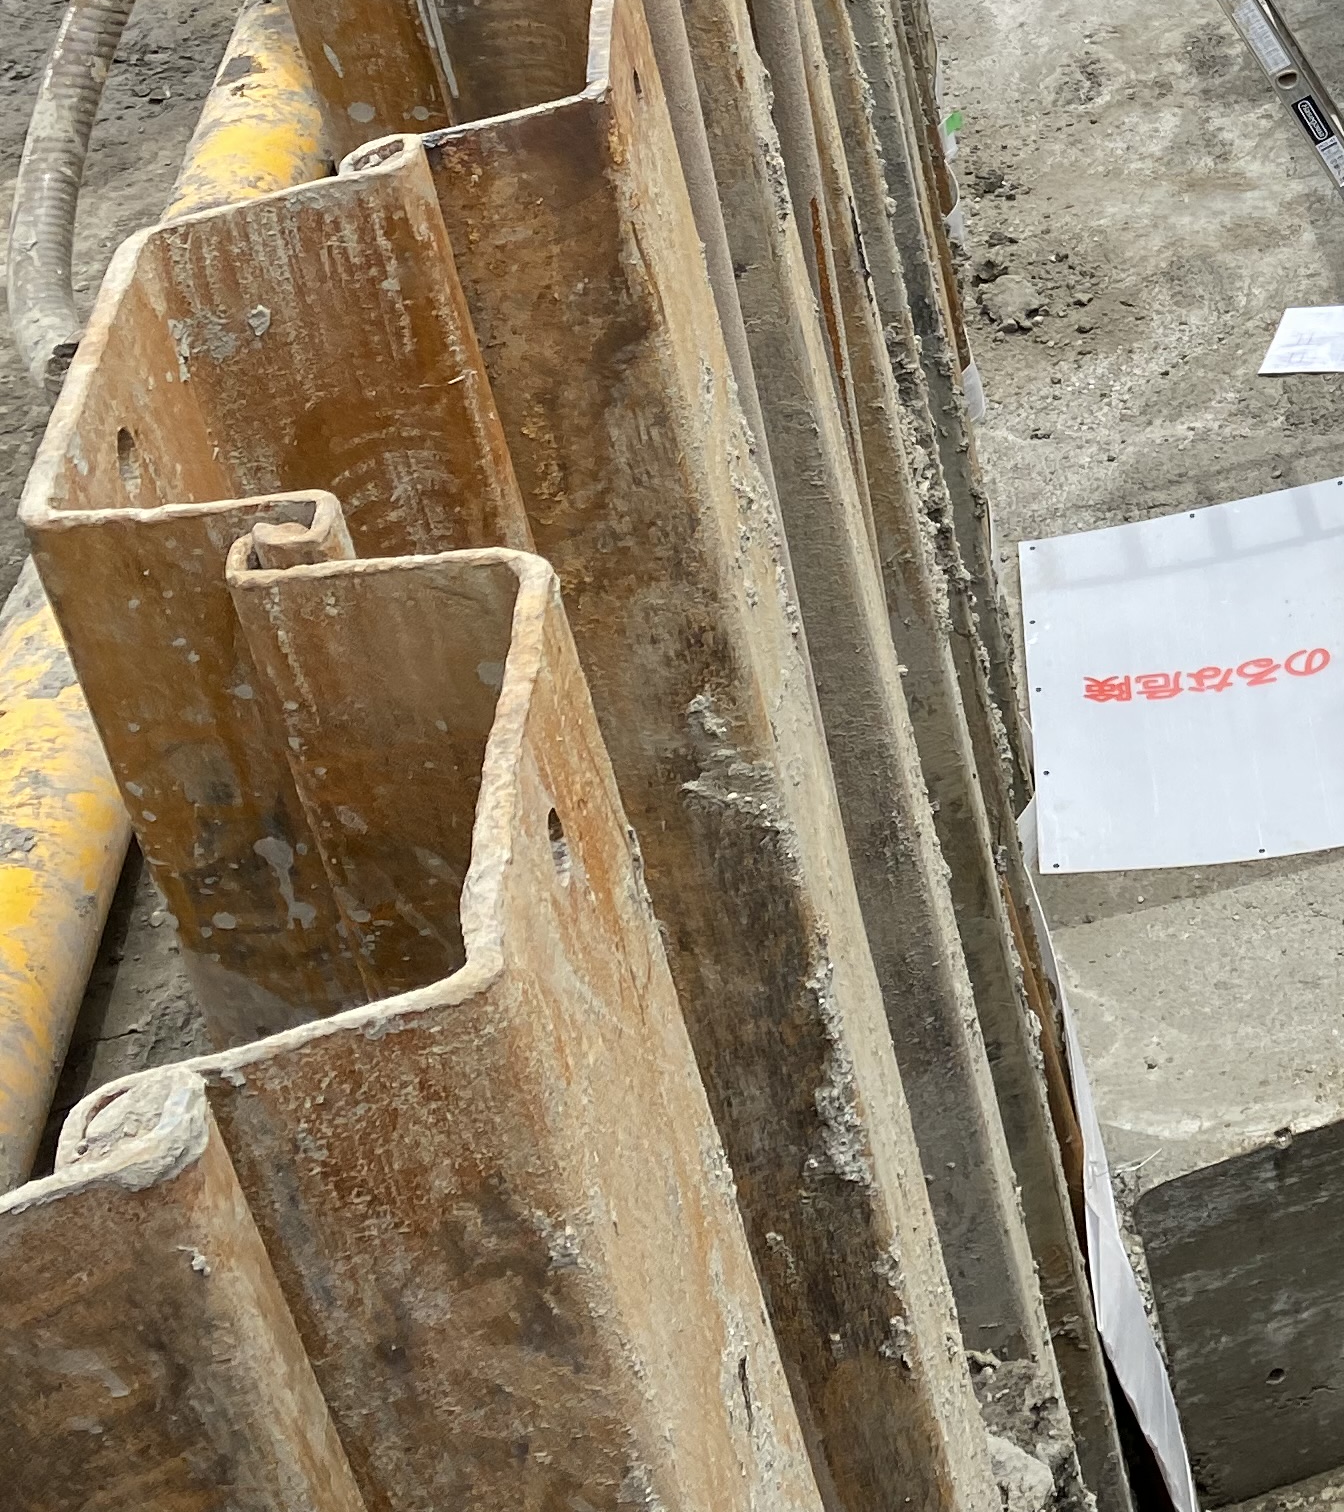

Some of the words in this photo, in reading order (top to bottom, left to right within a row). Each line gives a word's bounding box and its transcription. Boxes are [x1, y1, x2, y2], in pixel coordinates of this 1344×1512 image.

[1083, 647, 1331, 703] のるな危険
